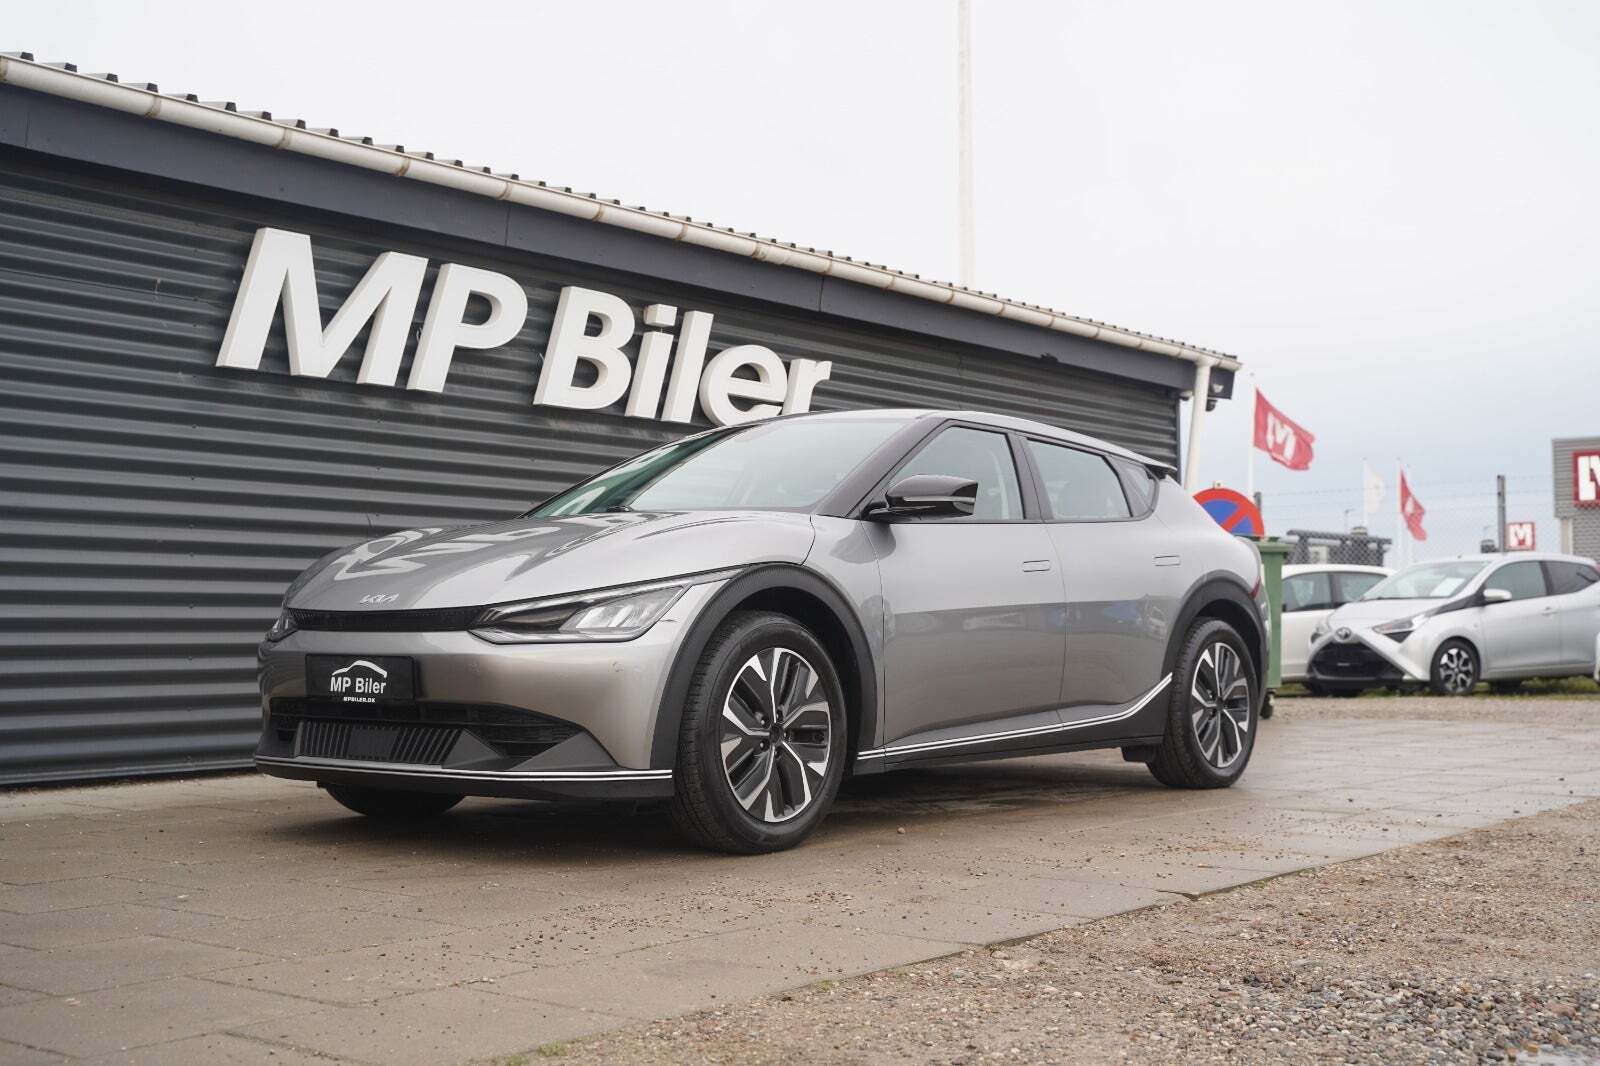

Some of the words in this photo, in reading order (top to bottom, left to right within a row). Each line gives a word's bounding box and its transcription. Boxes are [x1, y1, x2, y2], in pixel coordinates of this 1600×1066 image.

[215, 228, 528, 393] MP
[533, 286, 832, 427] Biler
[330, 677, 352, 693] MP
[355, 677, 387, 694] Biler
